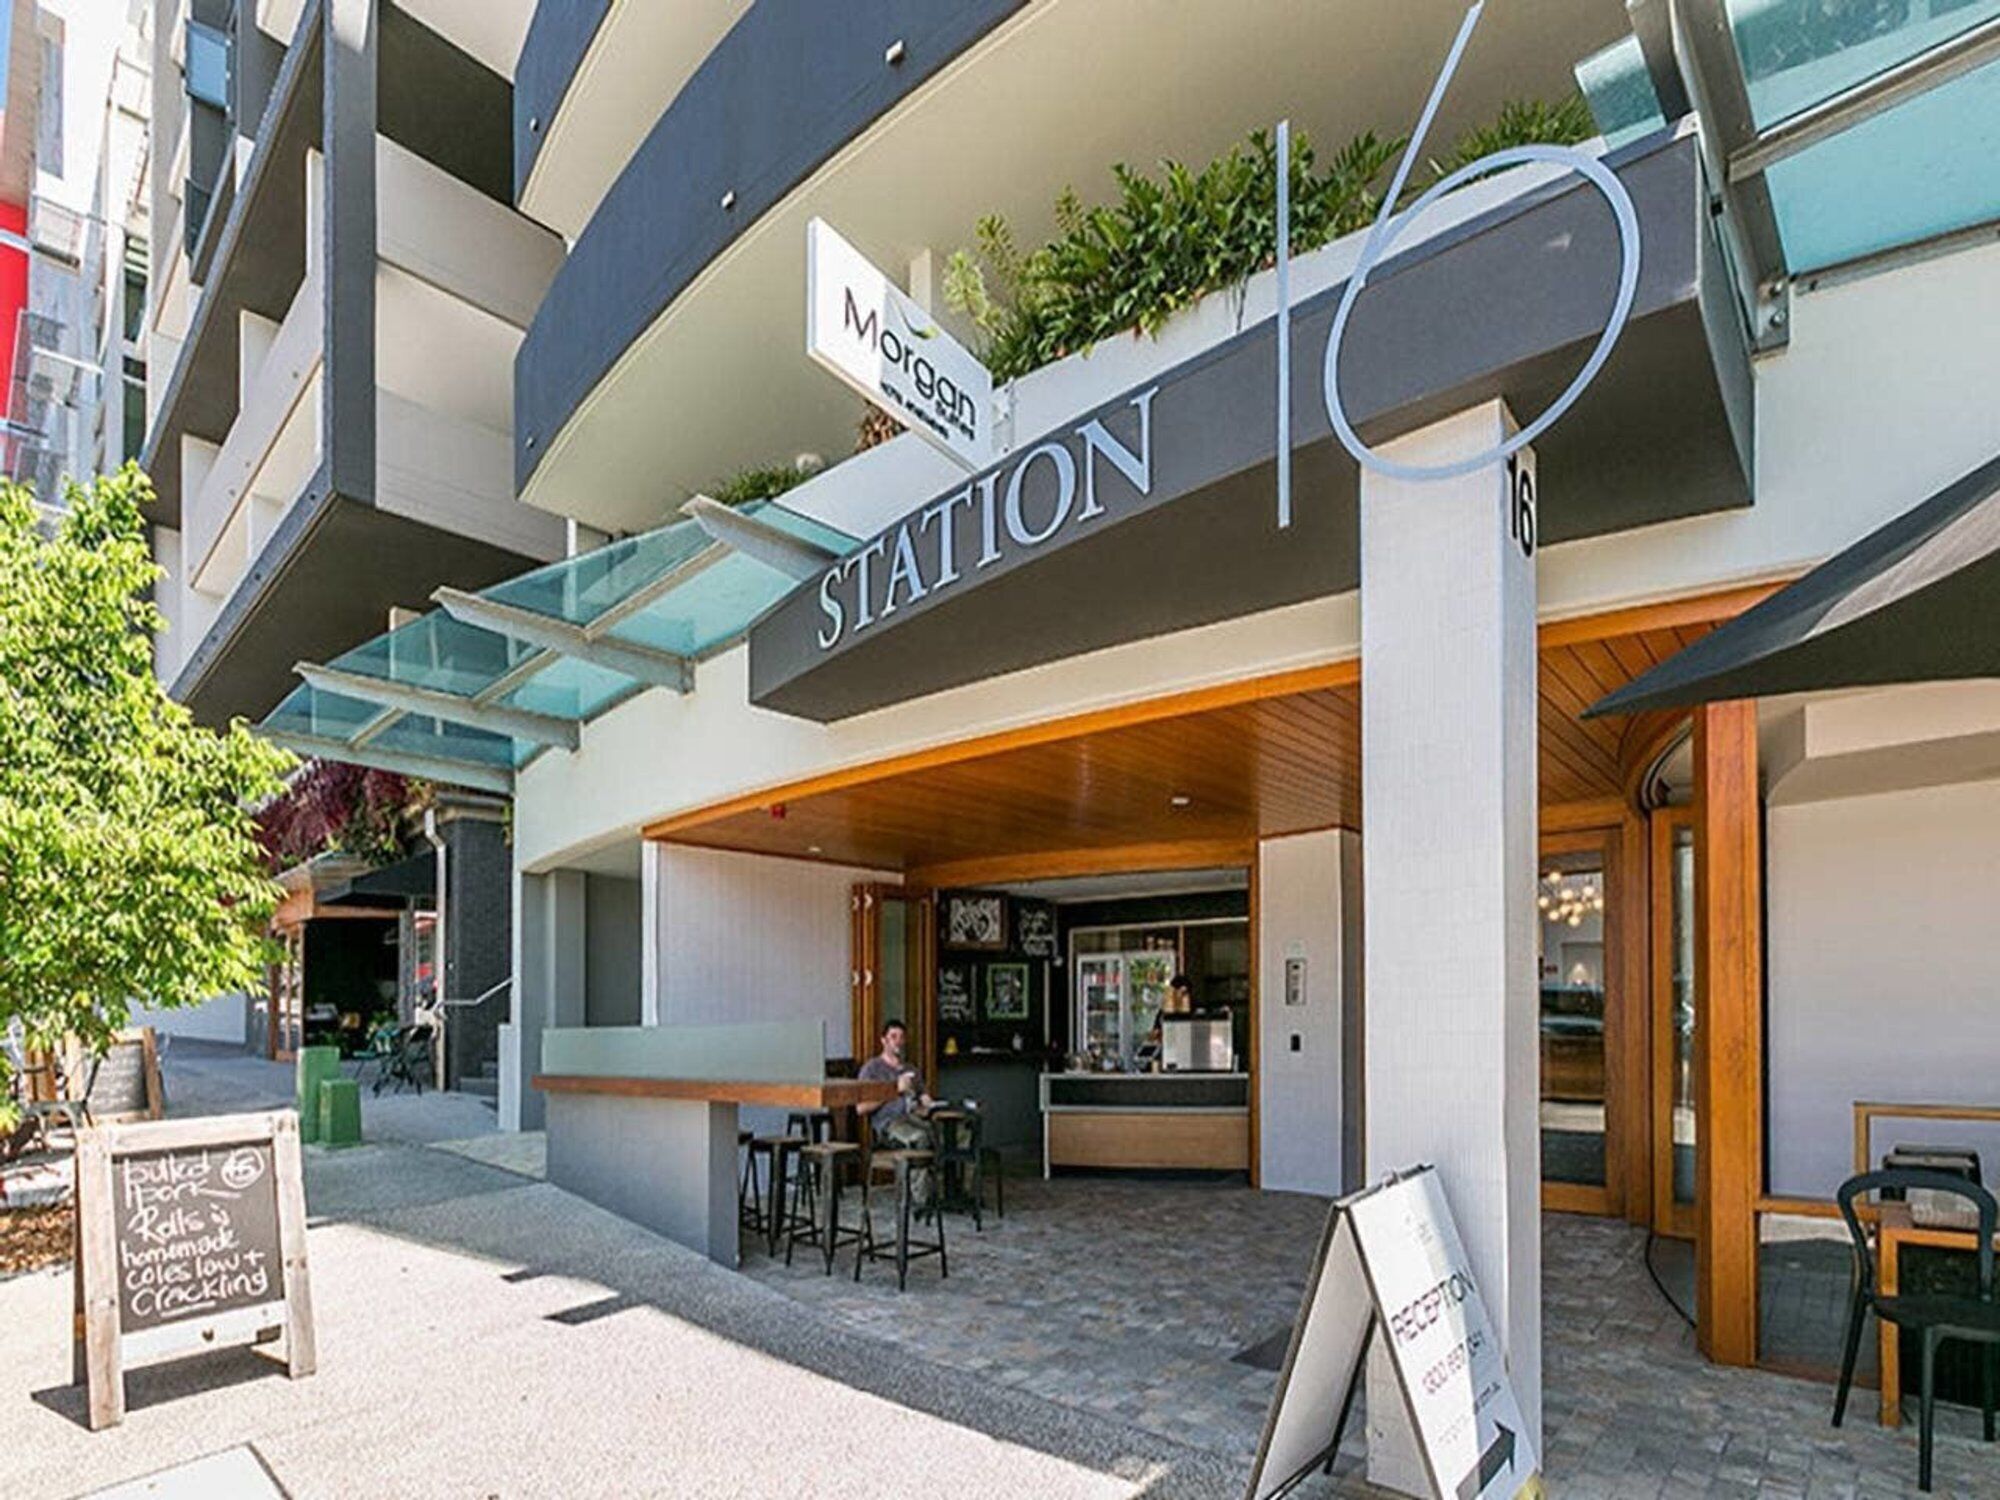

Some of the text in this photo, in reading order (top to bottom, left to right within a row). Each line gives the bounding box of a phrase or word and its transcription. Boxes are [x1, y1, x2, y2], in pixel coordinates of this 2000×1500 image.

[844, 286, 976, 426] Morgan
[817, 386, 1160, 650] STATION
[1507, 450, 1534, 558] 16
[1390, 1264, 1475, 1348] RECEPTION
